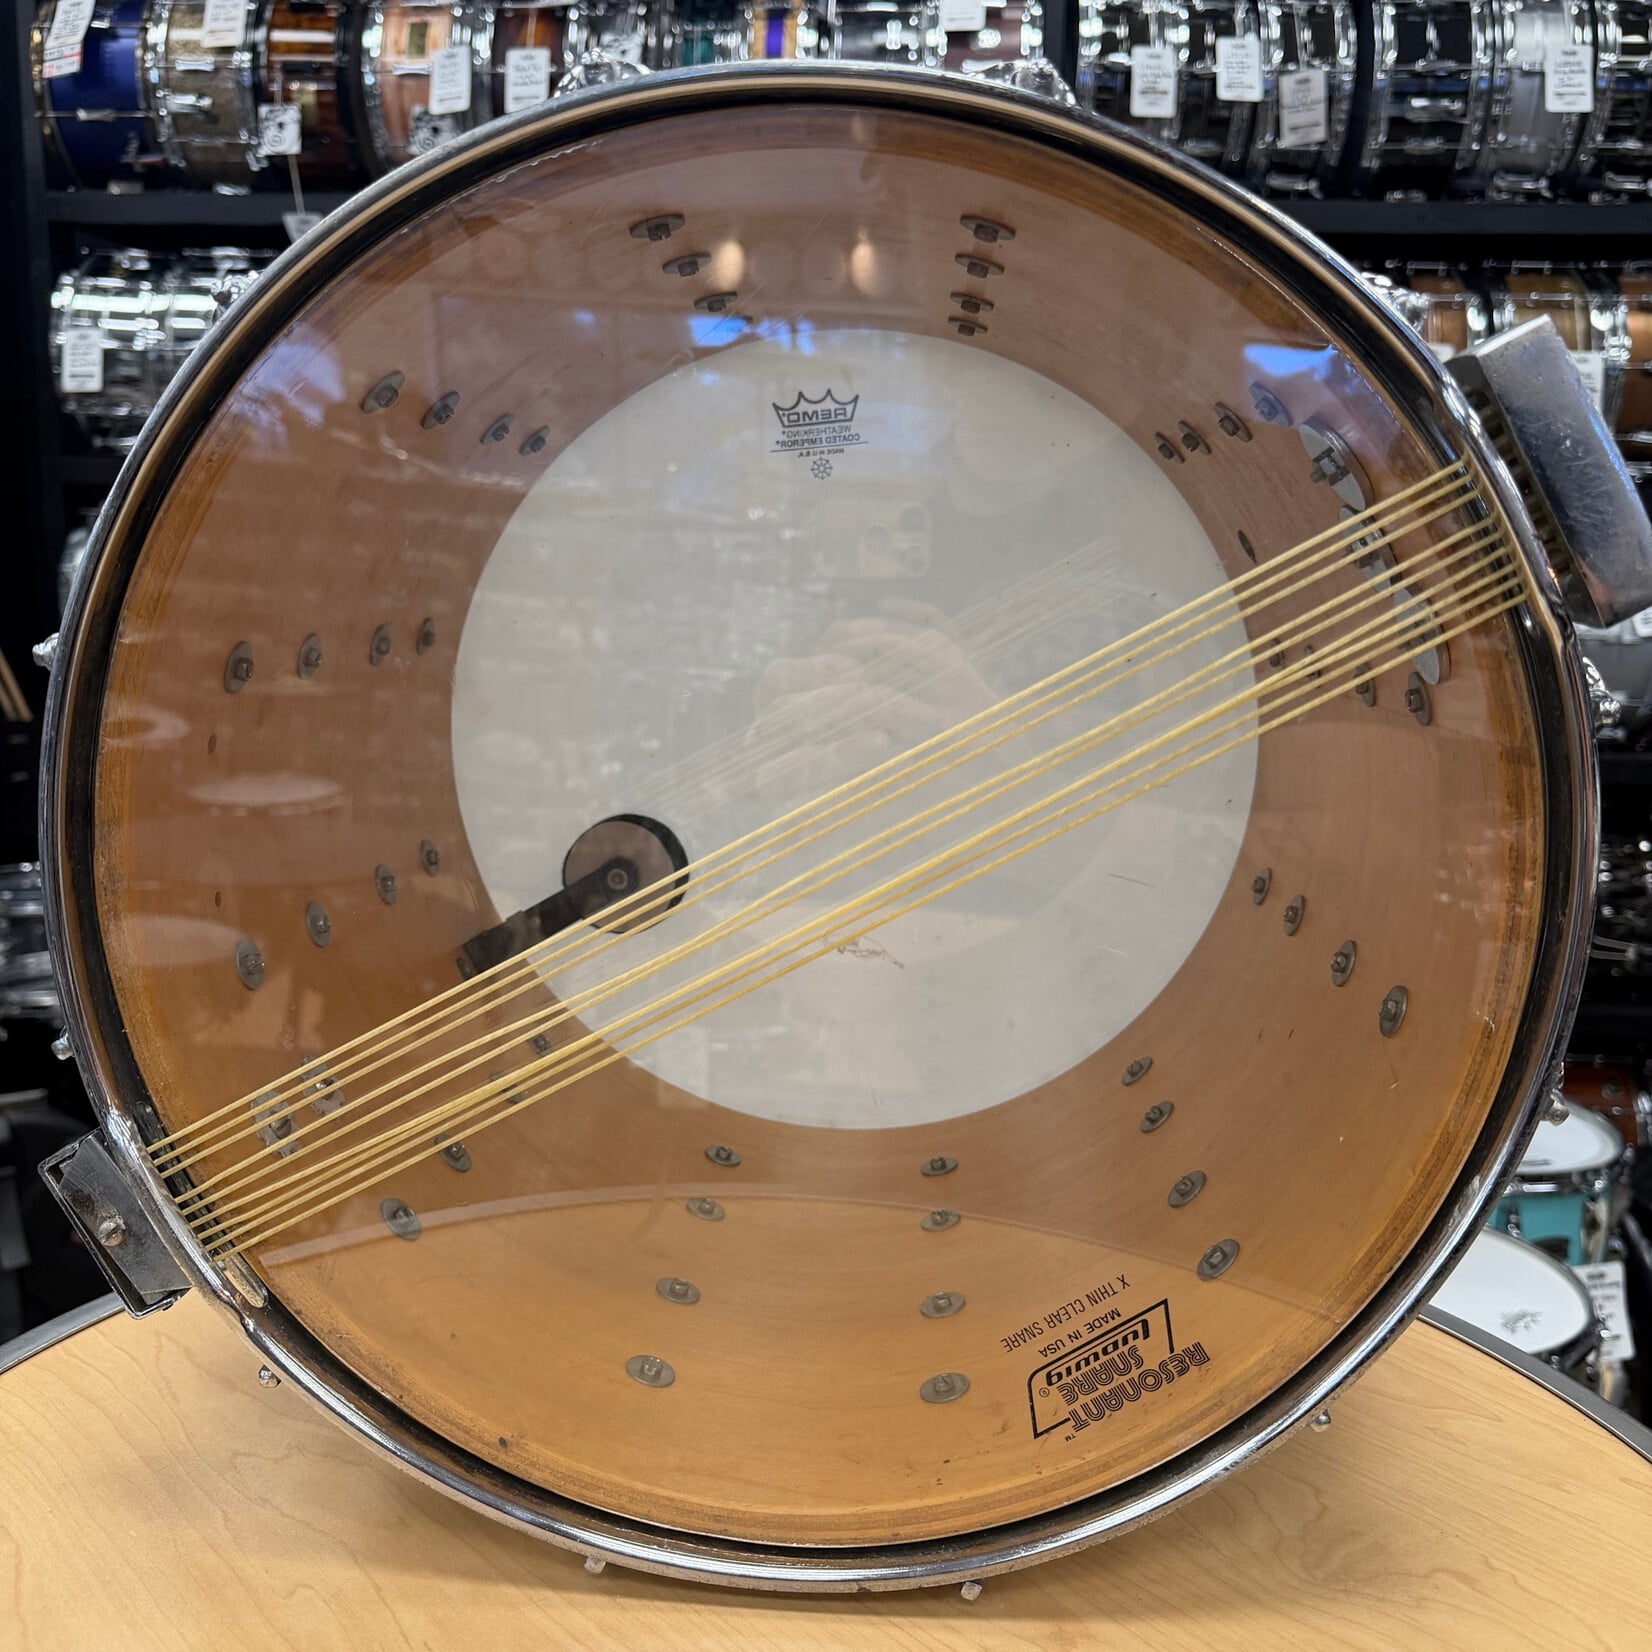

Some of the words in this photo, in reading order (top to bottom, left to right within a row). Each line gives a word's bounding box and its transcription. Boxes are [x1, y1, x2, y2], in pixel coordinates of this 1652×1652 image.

[1085, 1281, 1119, 1307] THIN
[1115, 1273, 1131, 1290] X
[1044, 1298, 1086, 1329] CLEAR
[1083, 1307, 1122, 1333] MADE
[1000, 1321, 1044, 1353] SNARE
[1038, 1338, 1066, 1358] USA
[1067, 1329, 1083, 1343] IN
[1056, 1344, 1144, 1406] SNARE
[1068, 1341, 1211, 1432] RESONANT
